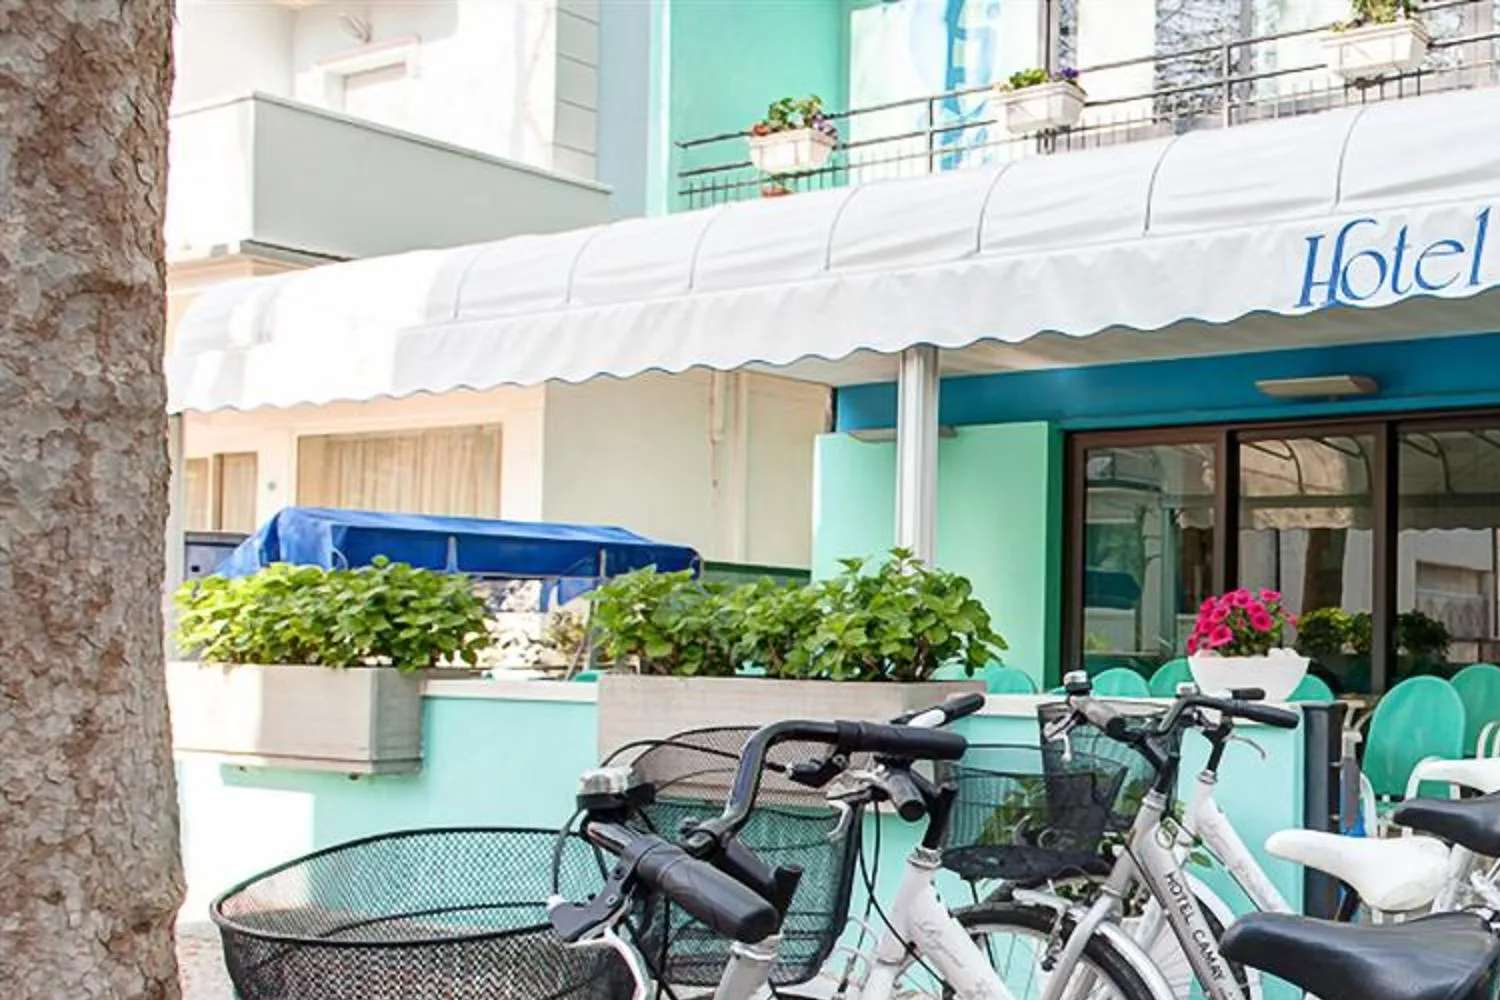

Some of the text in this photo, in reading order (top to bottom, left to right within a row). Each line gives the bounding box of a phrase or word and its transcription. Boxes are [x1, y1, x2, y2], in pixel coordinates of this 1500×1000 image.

[1294, 207, 1491, 309] Hotel
[1164, 871, 1227, 982] HOTEL CAMAY
